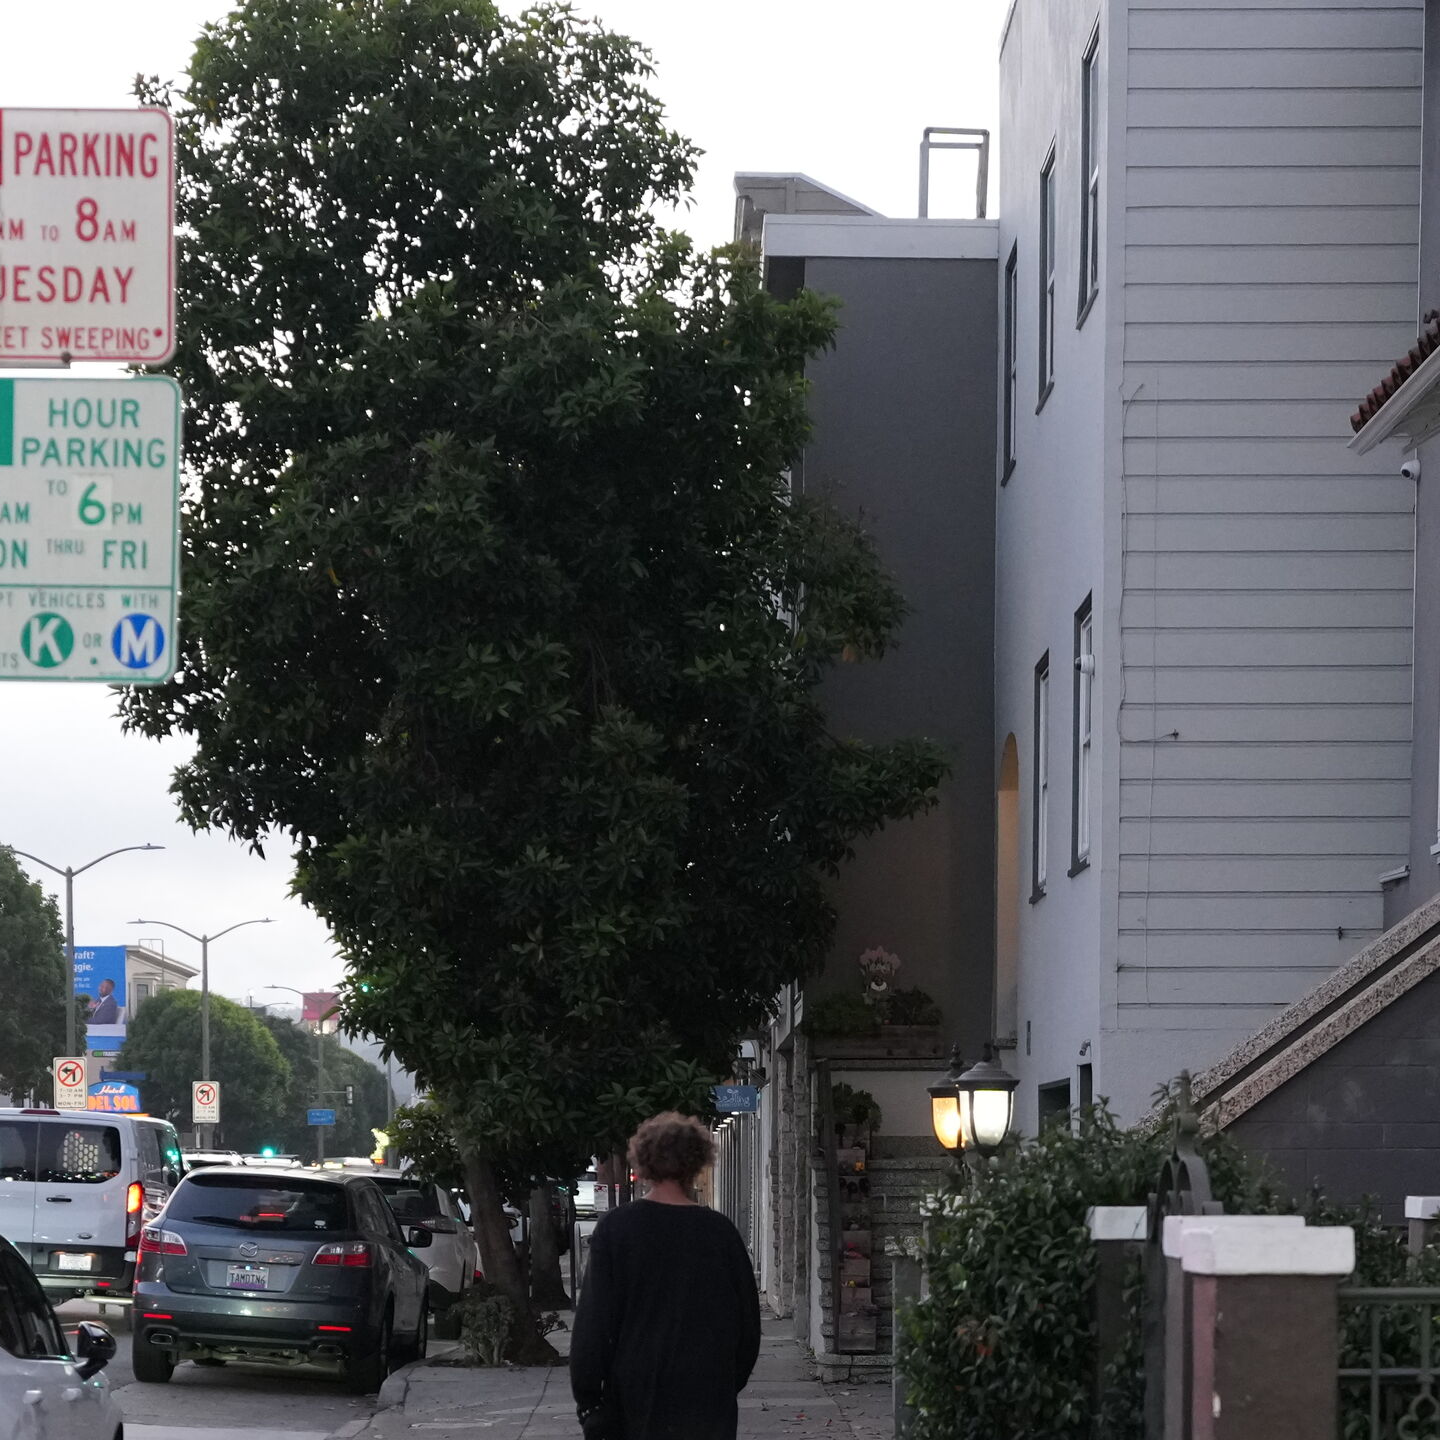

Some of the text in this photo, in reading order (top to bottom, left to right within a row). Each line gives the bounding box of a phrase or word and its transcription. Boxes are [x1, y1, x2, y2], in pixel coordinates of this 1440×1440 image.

[14, 132, 158, 178] PARKING
[41, 225, 58, 241] TO
[41, 326, 150, 350] SWEEPING
[48, 399, 139, 428] HOUR
[21, 438, 166, 468] PARKING
[47, 480, 67, 495] TO
[47, 539, 84, 555] THRU
[102, 541, 147, 570] FRI
[28, 593, 105, 608] VEHICLES
[122, 594, 159, 608] WITH
[29, 618, 63, 662] K
[83, 633, 102, 648] OR
[121, 619, 156, 663] M
[74, 950, 95, 960] raft?
[88, 1095, 138, 1111] DEL SOL
